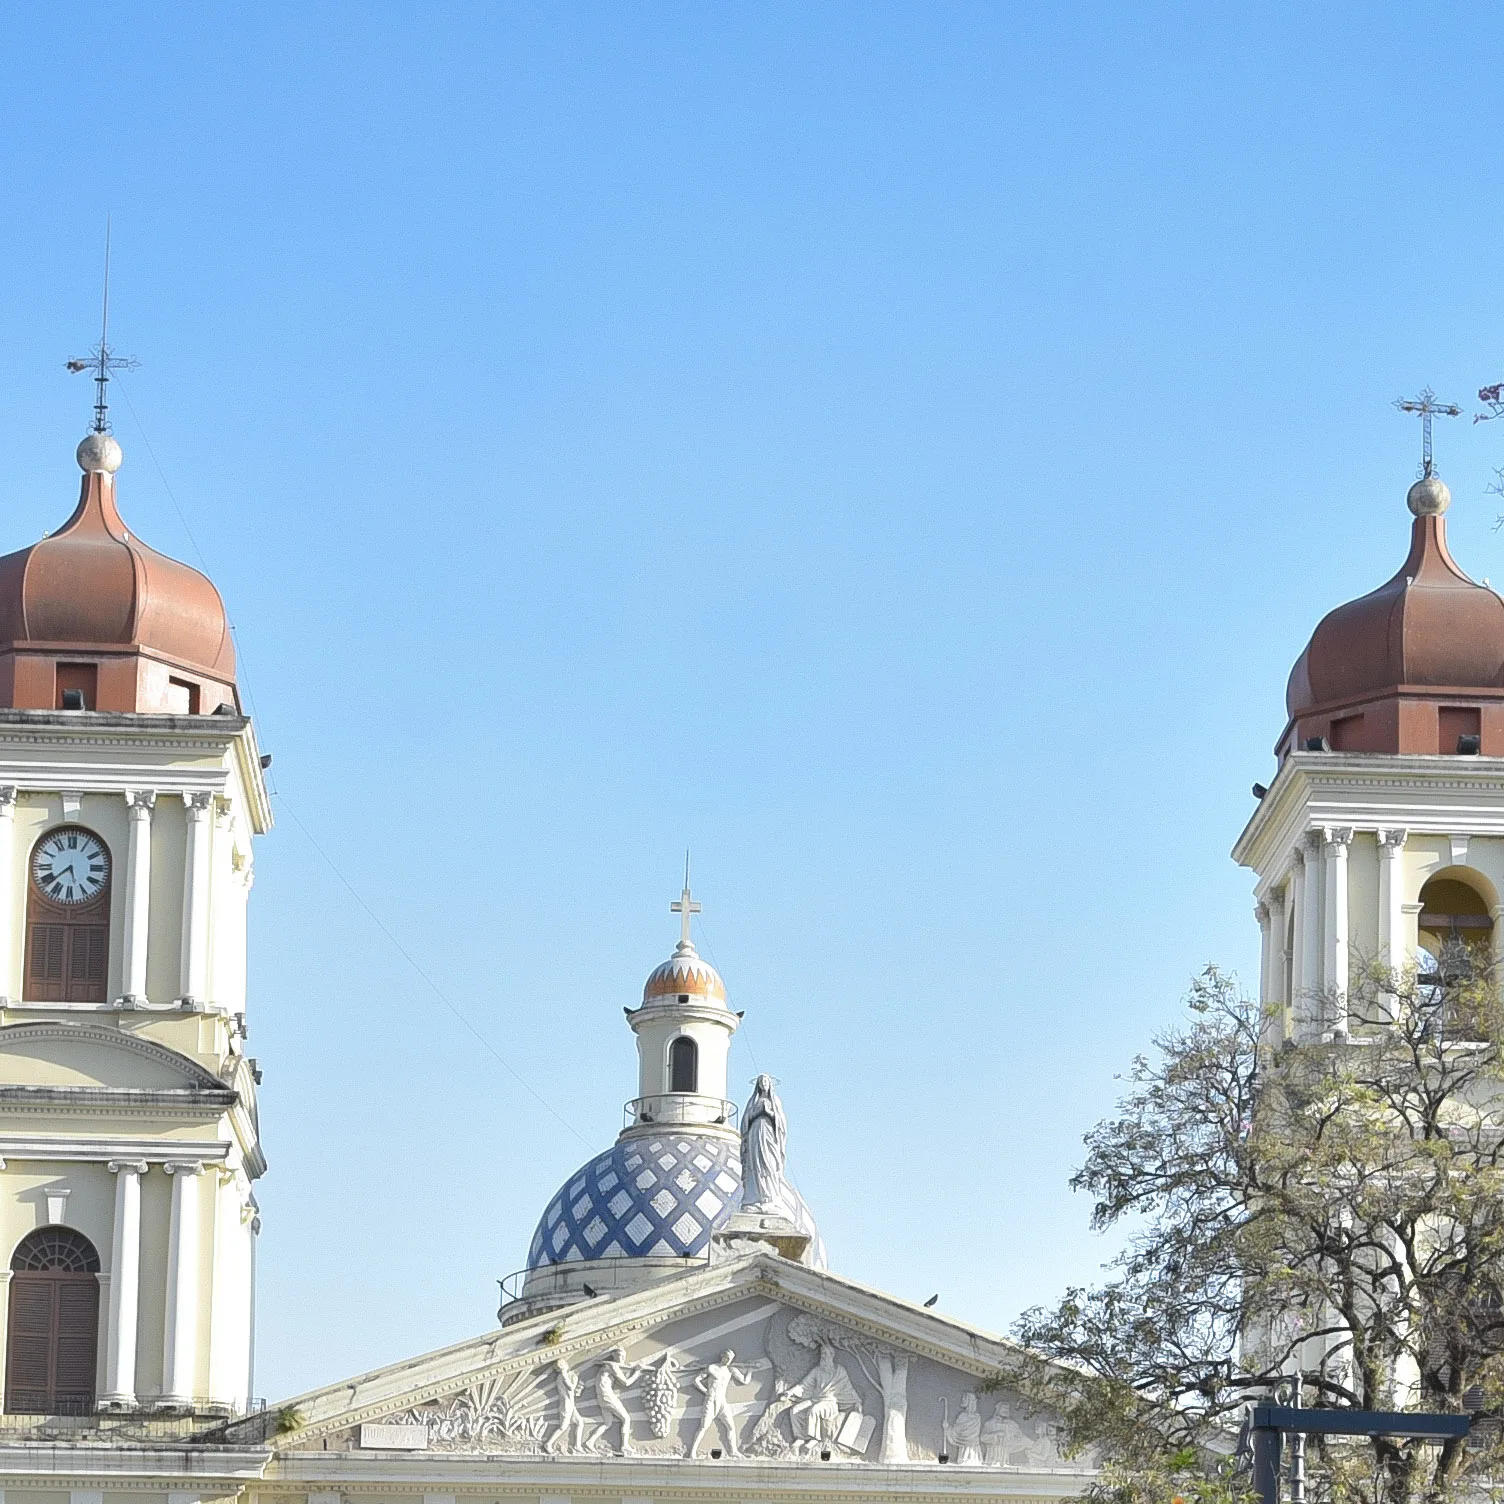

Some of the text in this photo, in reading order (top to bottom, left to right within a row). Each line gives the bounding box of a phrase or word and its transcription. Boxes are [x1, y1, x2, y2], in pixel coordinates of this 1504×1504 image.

[87, 851, 101, 861] II
[90, 864, 104, 873] III
[78, 883, 89, 896] V
